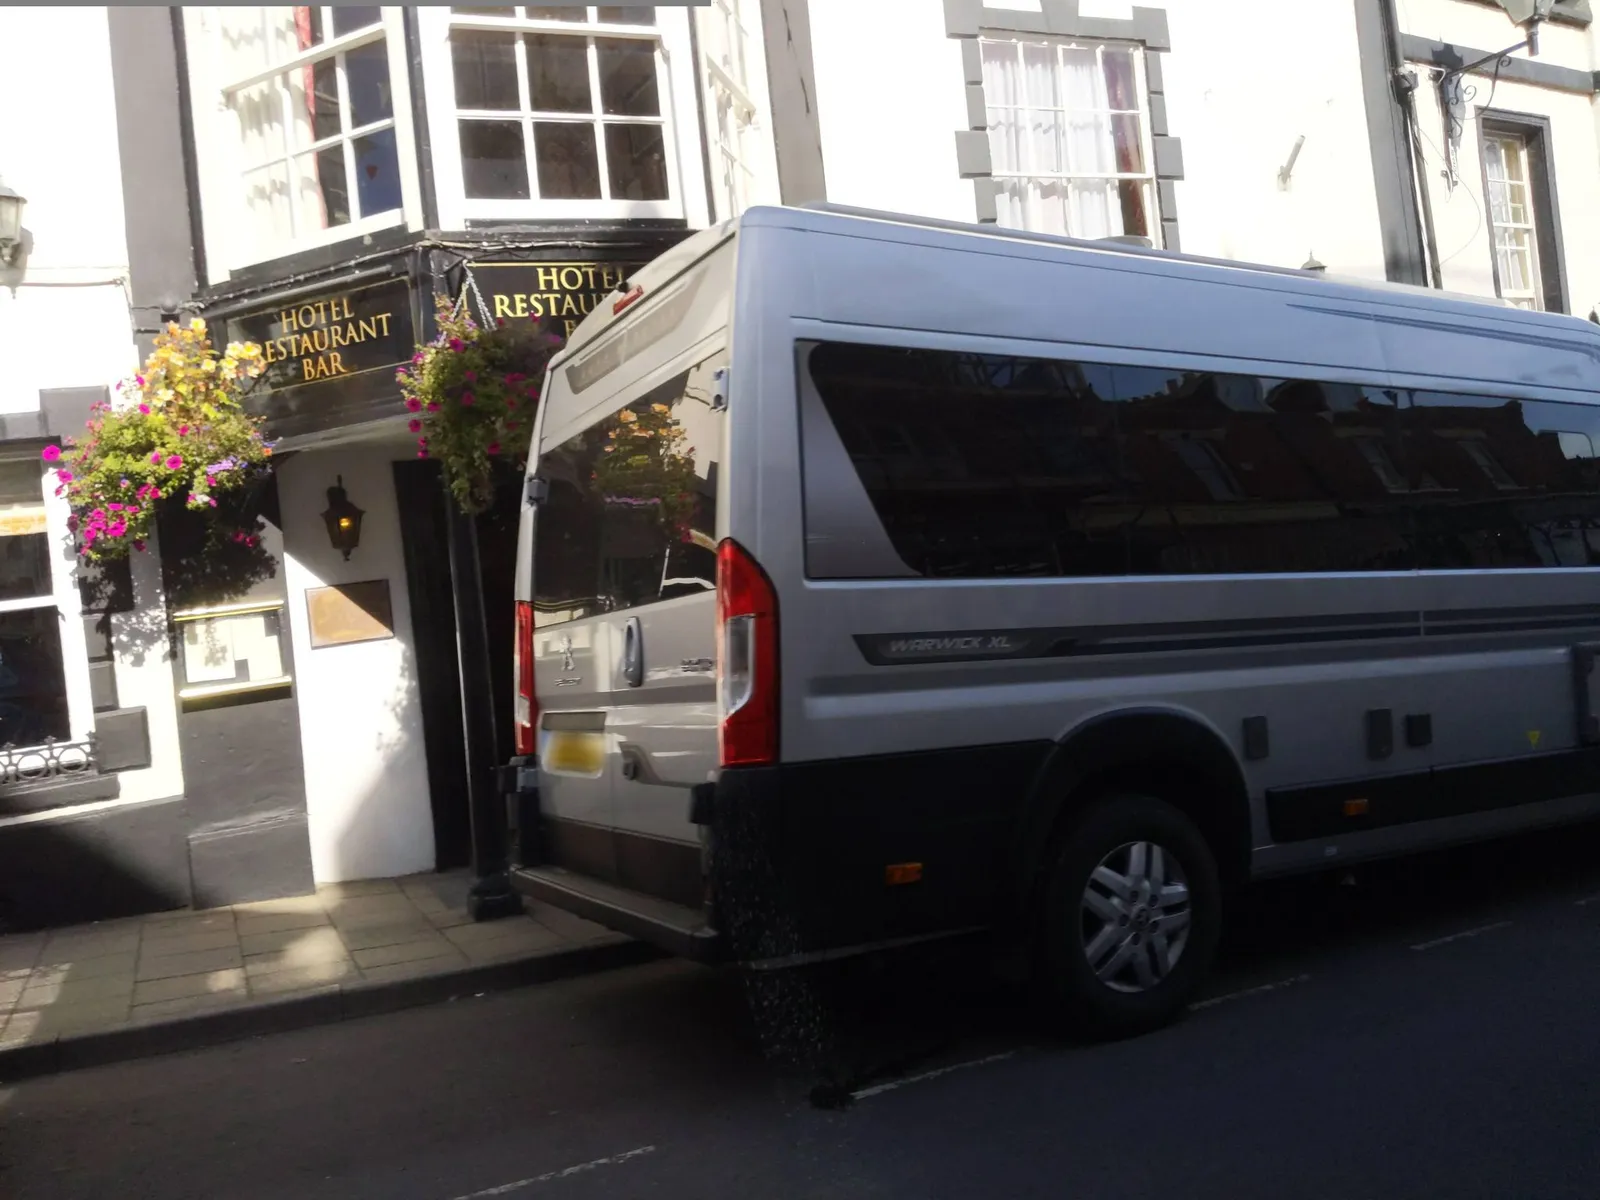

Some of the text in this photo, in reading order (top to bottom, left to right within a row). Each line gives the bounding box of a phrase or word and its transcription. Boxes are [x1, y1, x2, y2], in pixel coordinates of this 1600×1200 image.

[281, 297, 354, 333] HOTEL
[302, 352, 347, 381] BAR
[890, 635, 1011, 652] WARWICK XL
